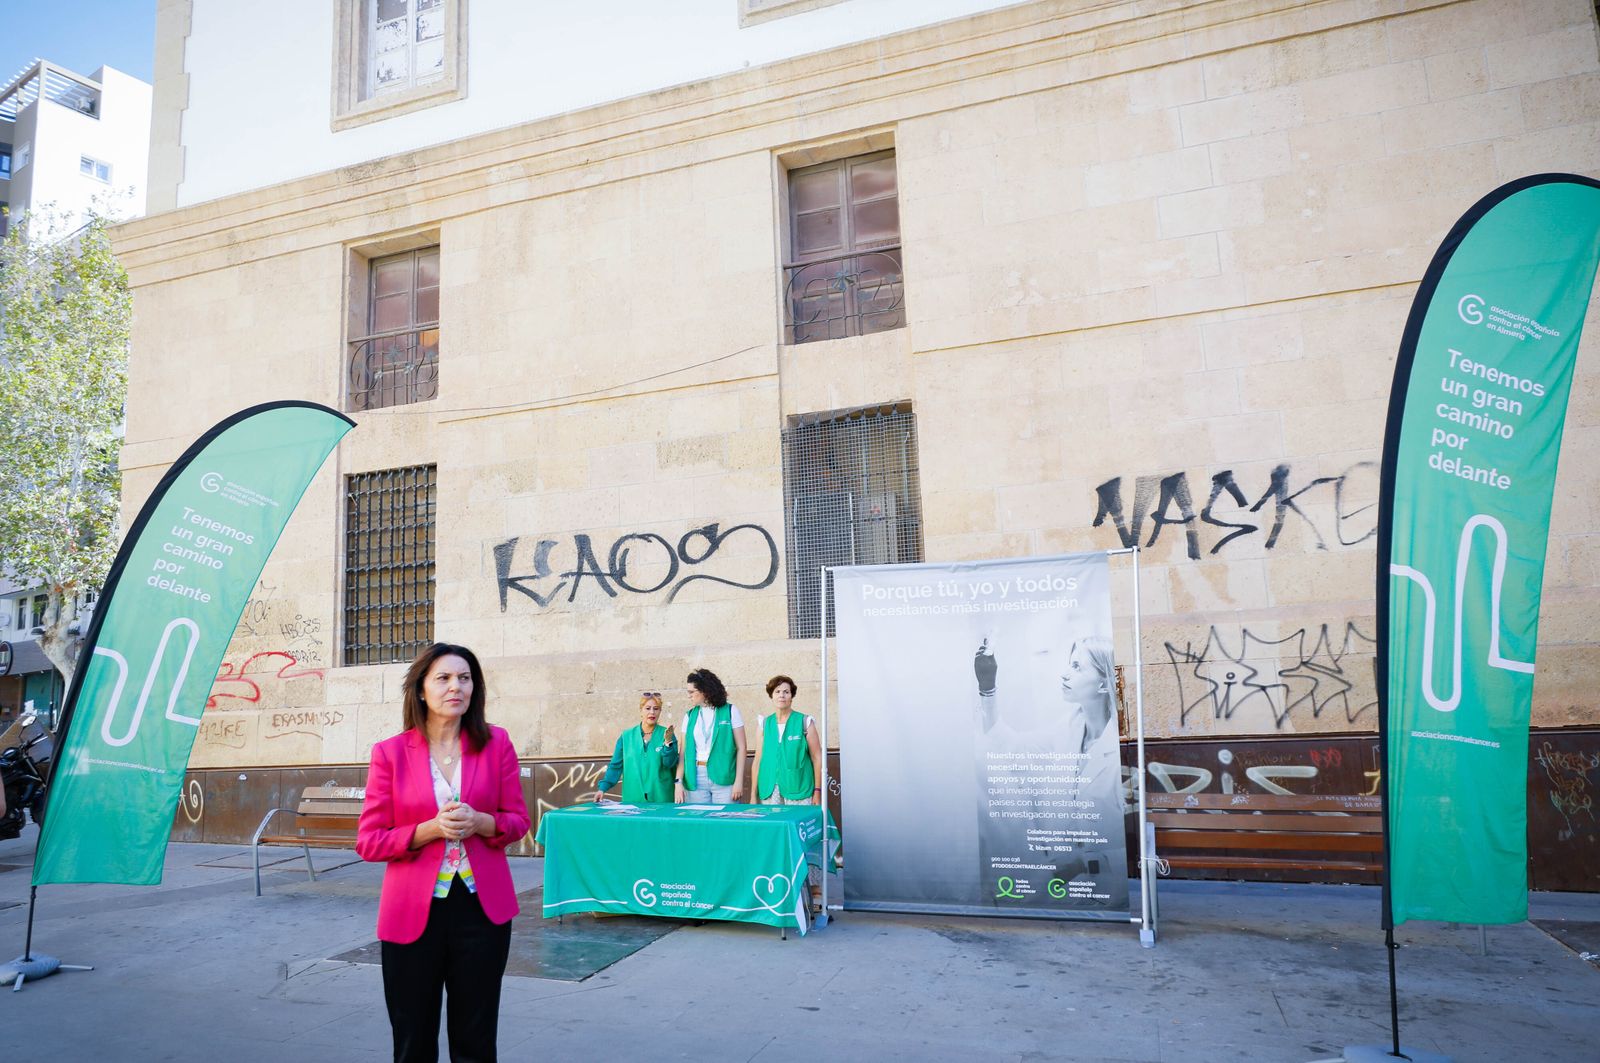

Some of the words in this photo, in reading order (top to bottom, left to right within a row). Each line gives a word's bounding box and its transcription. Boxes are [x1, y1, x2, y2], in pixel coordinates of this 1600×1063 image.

[1488, 314, 1512, 327] contra
[1513, 322, 1522, 330] el
[1491, 305, 1530, 323] asociación
[1486, 322, 1497, 331] en
[1447, 348, 1546, 397] Tenemos
[1441, 377, 1469, 399] un
[1471, 389, 1523, 416] gran
[1436, 402, 1514, 439] camino
[1431, 427, 1469, 450] por
[1428, 451, 1512, 490] delante
[182, 506, 255, 545] Tenemos
[171, 525, 194, 541] un
[194, 535, 234, 556] gran
[163, 542, 224, 570] camino
[152, 558, 185, 575] por
[147, 574, 212, 603] delante
[862, 583, 933, 603] Porque
[938, 580, 964, 599] tú,
[969, 581, 993, 599] yo
[998, 580, 1011, 599] y
[1016, 574, 1078, 593] todos
[863, 604, 949, 617] necesitamos
[952, 601, 981, 614] más
[984, 597, 1079, 613] investigación
[987, 751, 1025, 760] Nuestros
[1027, 751, 1092, 762] investigadores
[987, 763, 1028, 771] necesitan
[1030, 763, 1044, 771] los
[1045, 763, 1080, 771] mismos
[987, 776, 1019, 784] apoyos
[1027, 775, 1092, 784] oportunidades
[988, 787, 1004, 796] que
[1006, 786, 1067, 796] investigadores
[988, 798, 1015, 807] países
[1052, 799, 1095, 809] estrategia
[989, 810, 1000, 818] en
[1001, 809, 1057, 820] investigación
[660, 882, 696, 891] asociación
[660, 891, 692, 900] española
[684, 900, 690, 908] el
